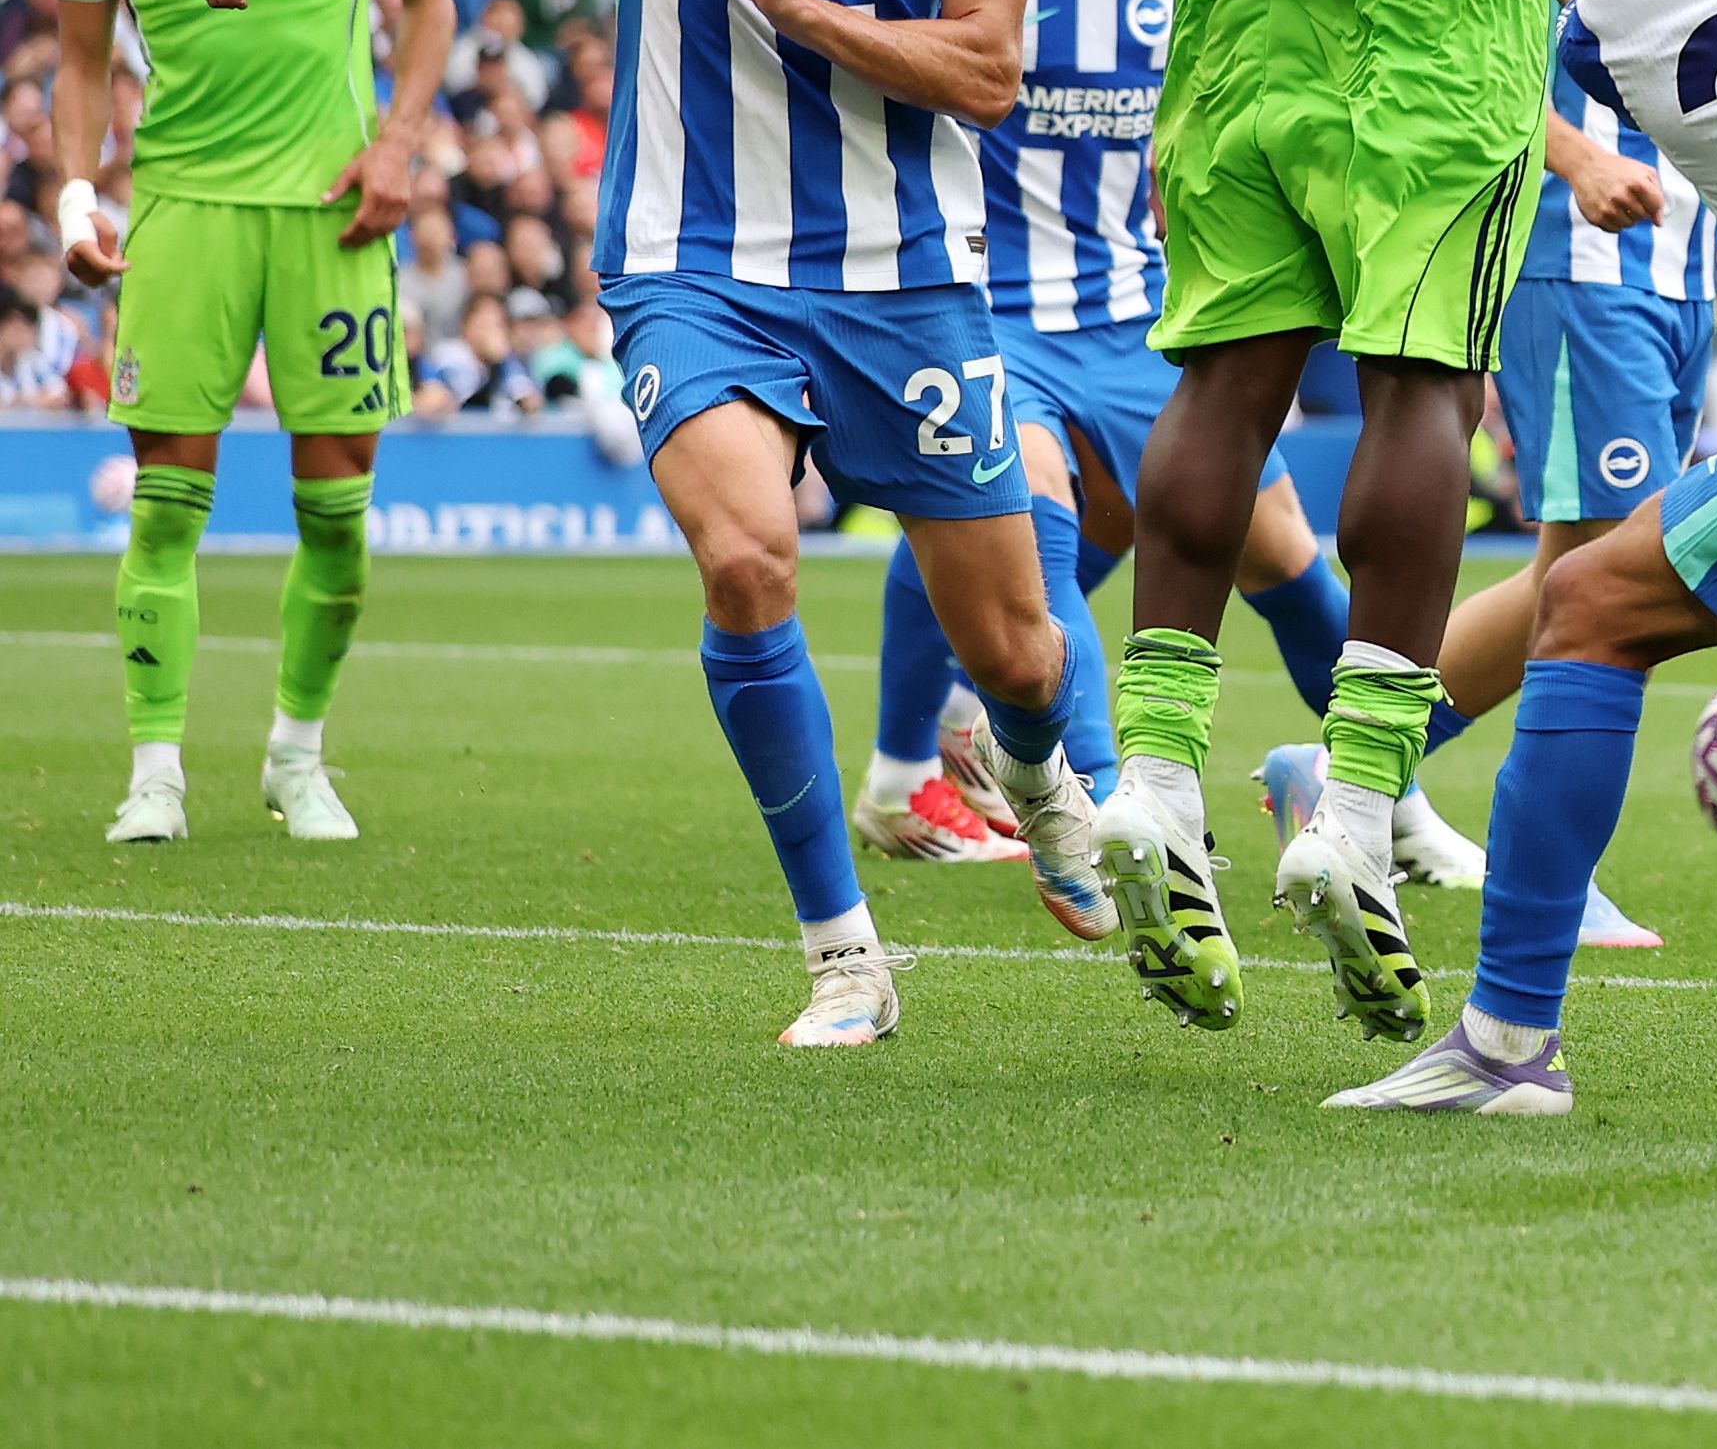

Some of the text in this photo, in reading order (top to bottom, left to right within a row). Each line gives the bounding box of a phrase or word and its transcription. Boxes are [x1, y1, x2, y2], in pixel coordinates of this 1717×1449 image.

[1016, 83, 1162, 114] AMERICAN
[319, 307, 391, 375] 20
[904, 354, 1005, 455] 27
